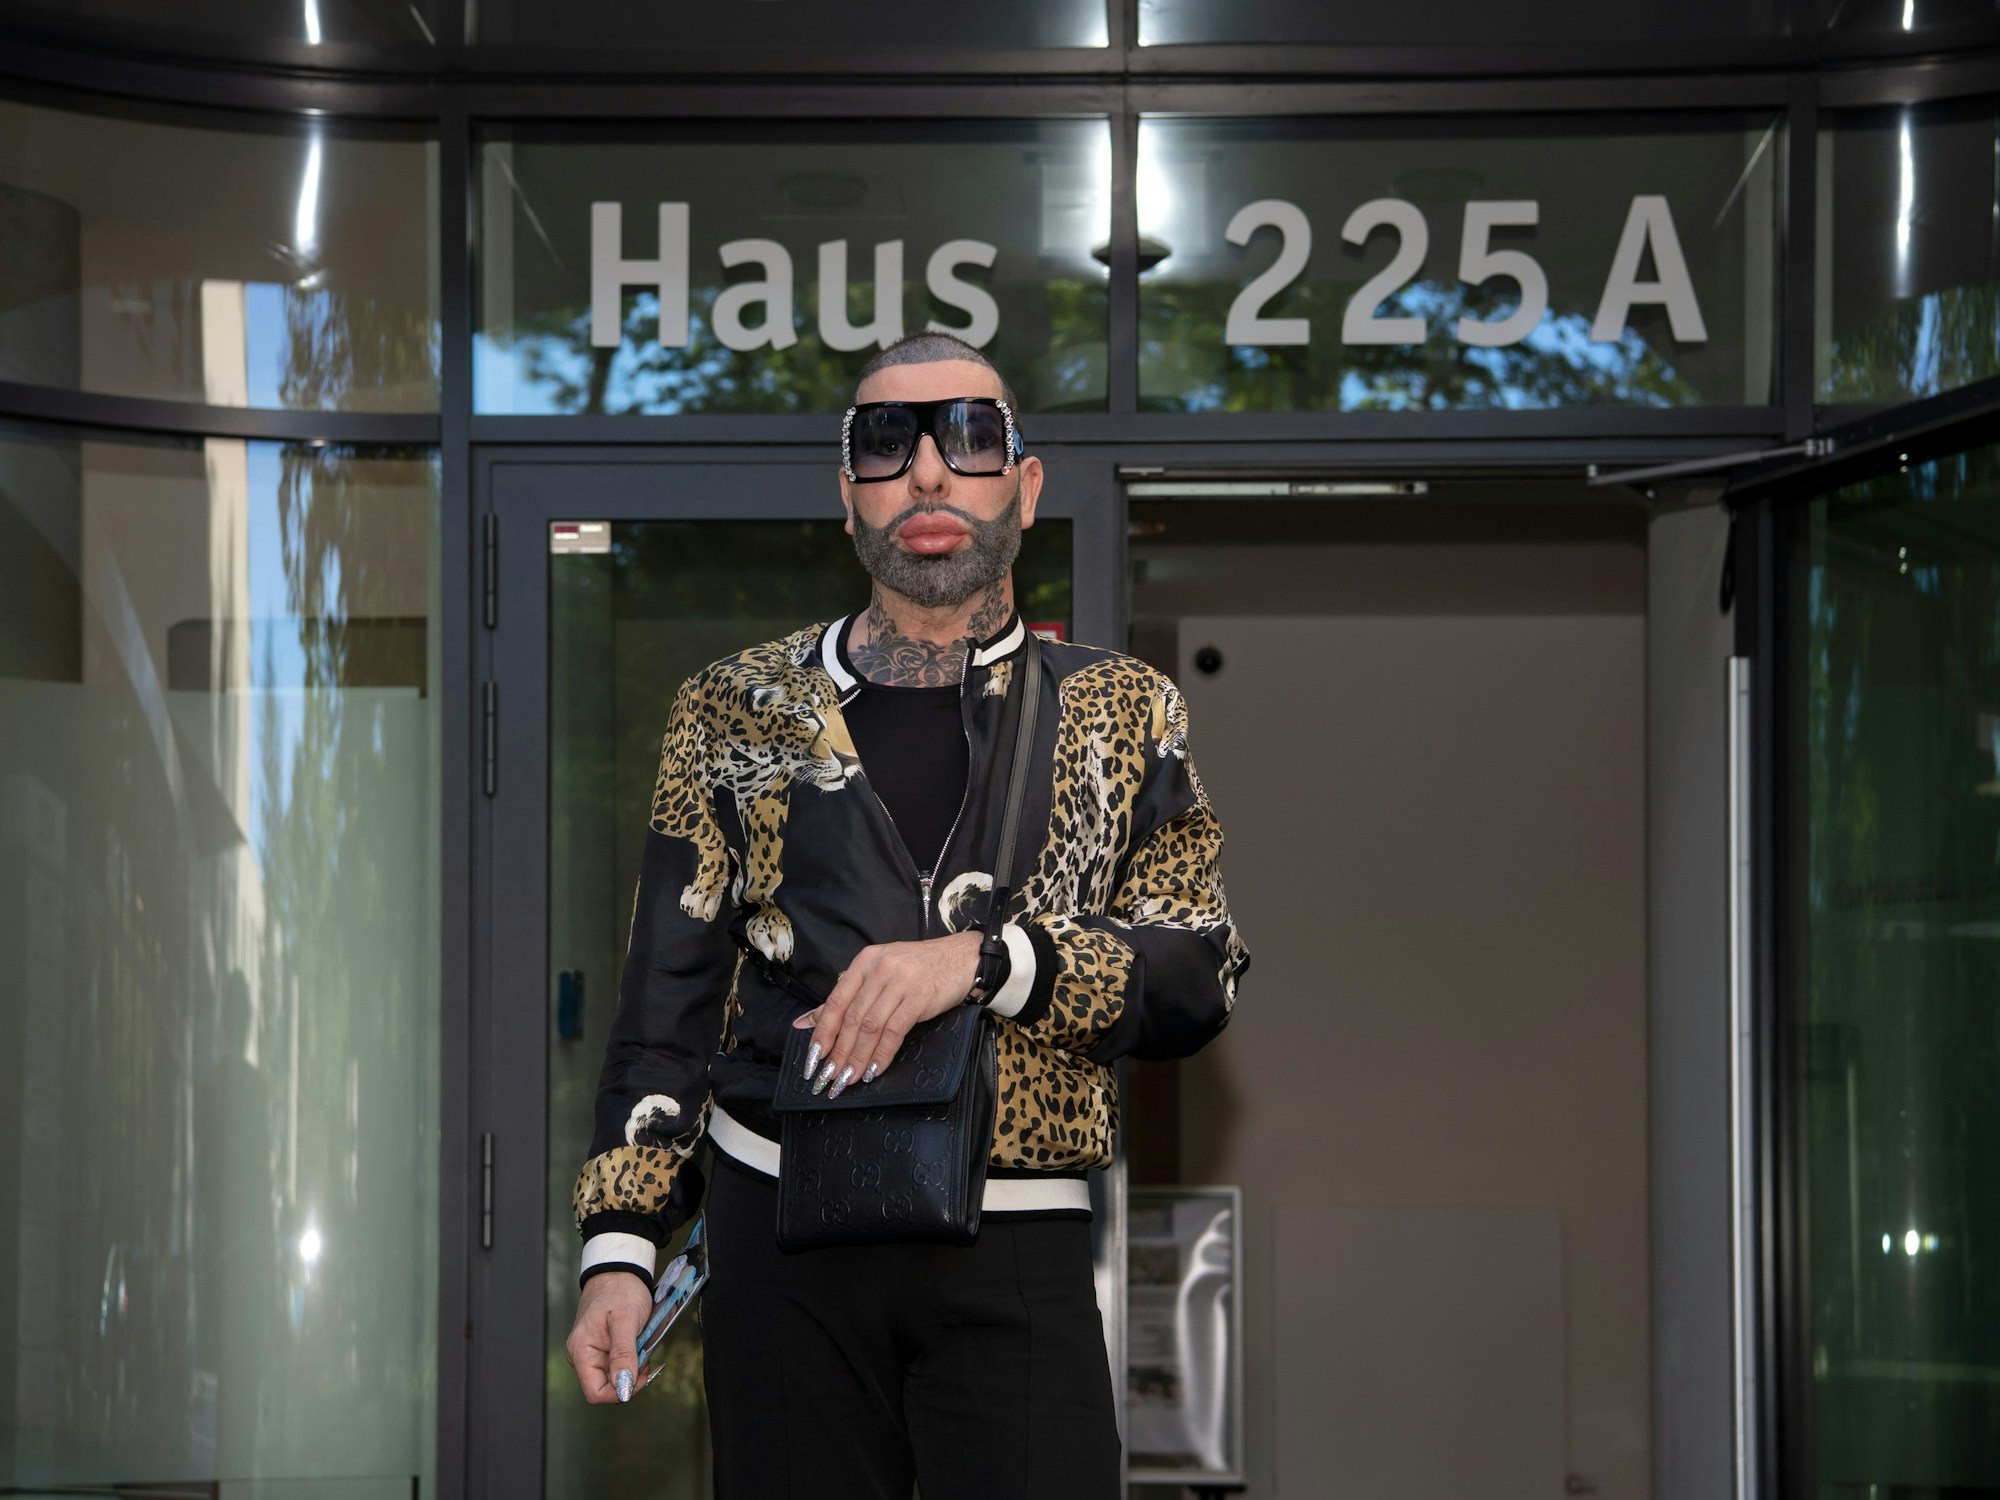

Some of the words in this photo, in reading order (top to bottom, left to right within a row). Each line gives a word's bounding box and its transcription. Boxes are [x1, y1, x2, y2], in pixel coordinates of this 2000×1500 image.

[590, 201, 999, 352] Haus
[1224, 198, 1549, 348] 225
[1591, 194, 1709, 344] A
